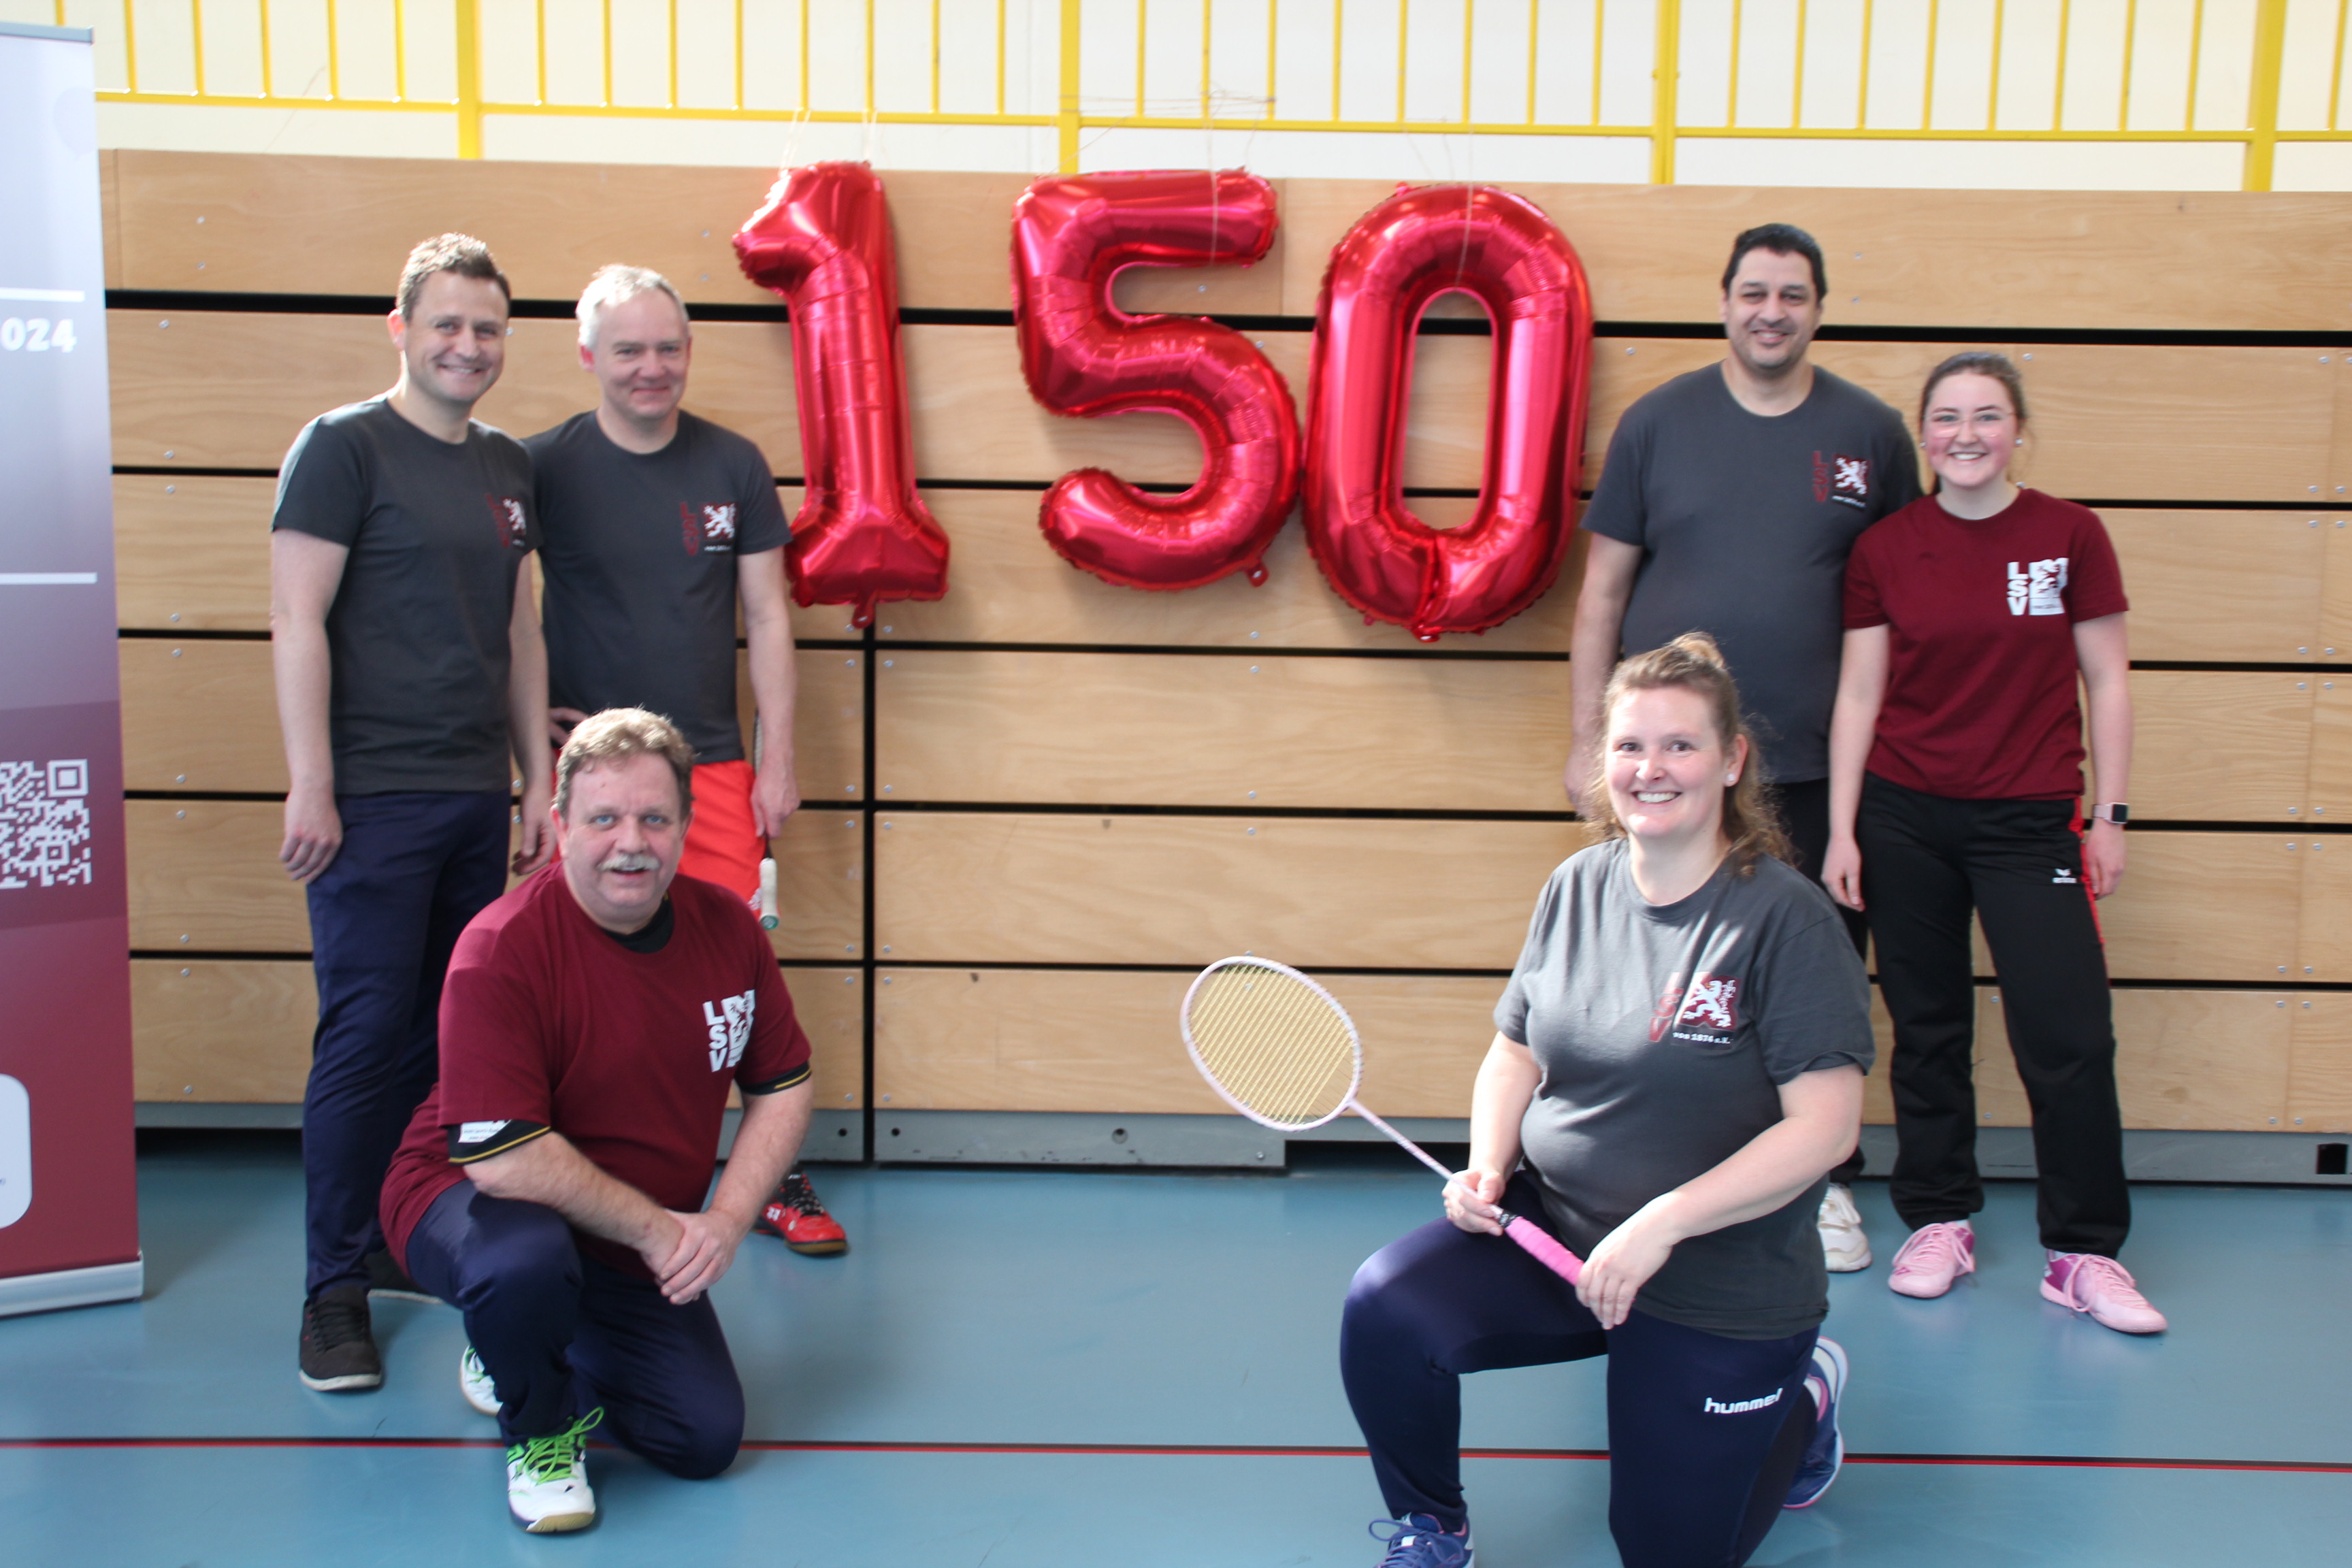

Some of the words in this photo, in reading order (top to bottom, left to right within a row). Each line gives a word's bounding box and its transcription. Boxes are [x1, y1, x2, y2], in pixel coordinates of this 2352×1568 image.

[0, 316, 78, 353] 024
[2006, 561, 2029, 616] LSV
[1649, 972, 1684, 1043] LSV
[702, 1000, 728, 1073] LSV
[1672, 1032, 1690, 1040] von
[1690, 1033, 1714, 1043] 1874
[1703, 1387, 1784, 1414] hummel
